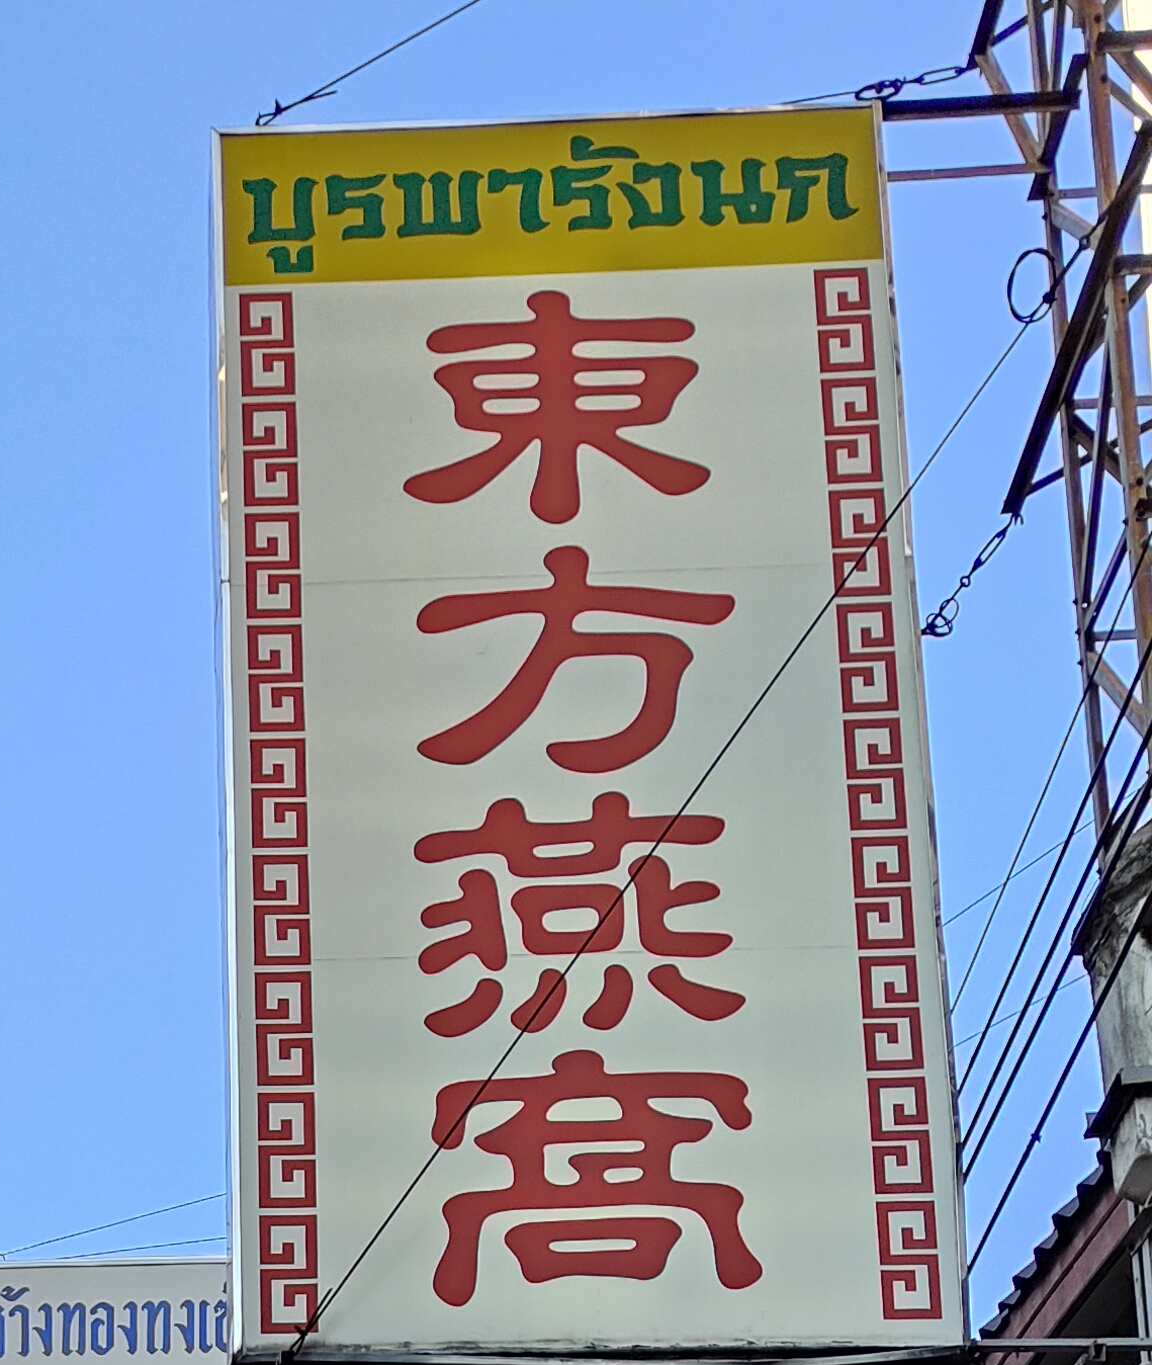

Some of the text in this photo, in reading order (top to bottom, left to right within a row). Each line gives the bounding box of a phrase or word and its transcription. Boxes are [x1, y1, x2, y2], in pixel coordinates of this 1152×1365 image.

[242, 135, 859, 273] บูรพารังนก
[404, 289, 764, 1307] 東方燕窩
